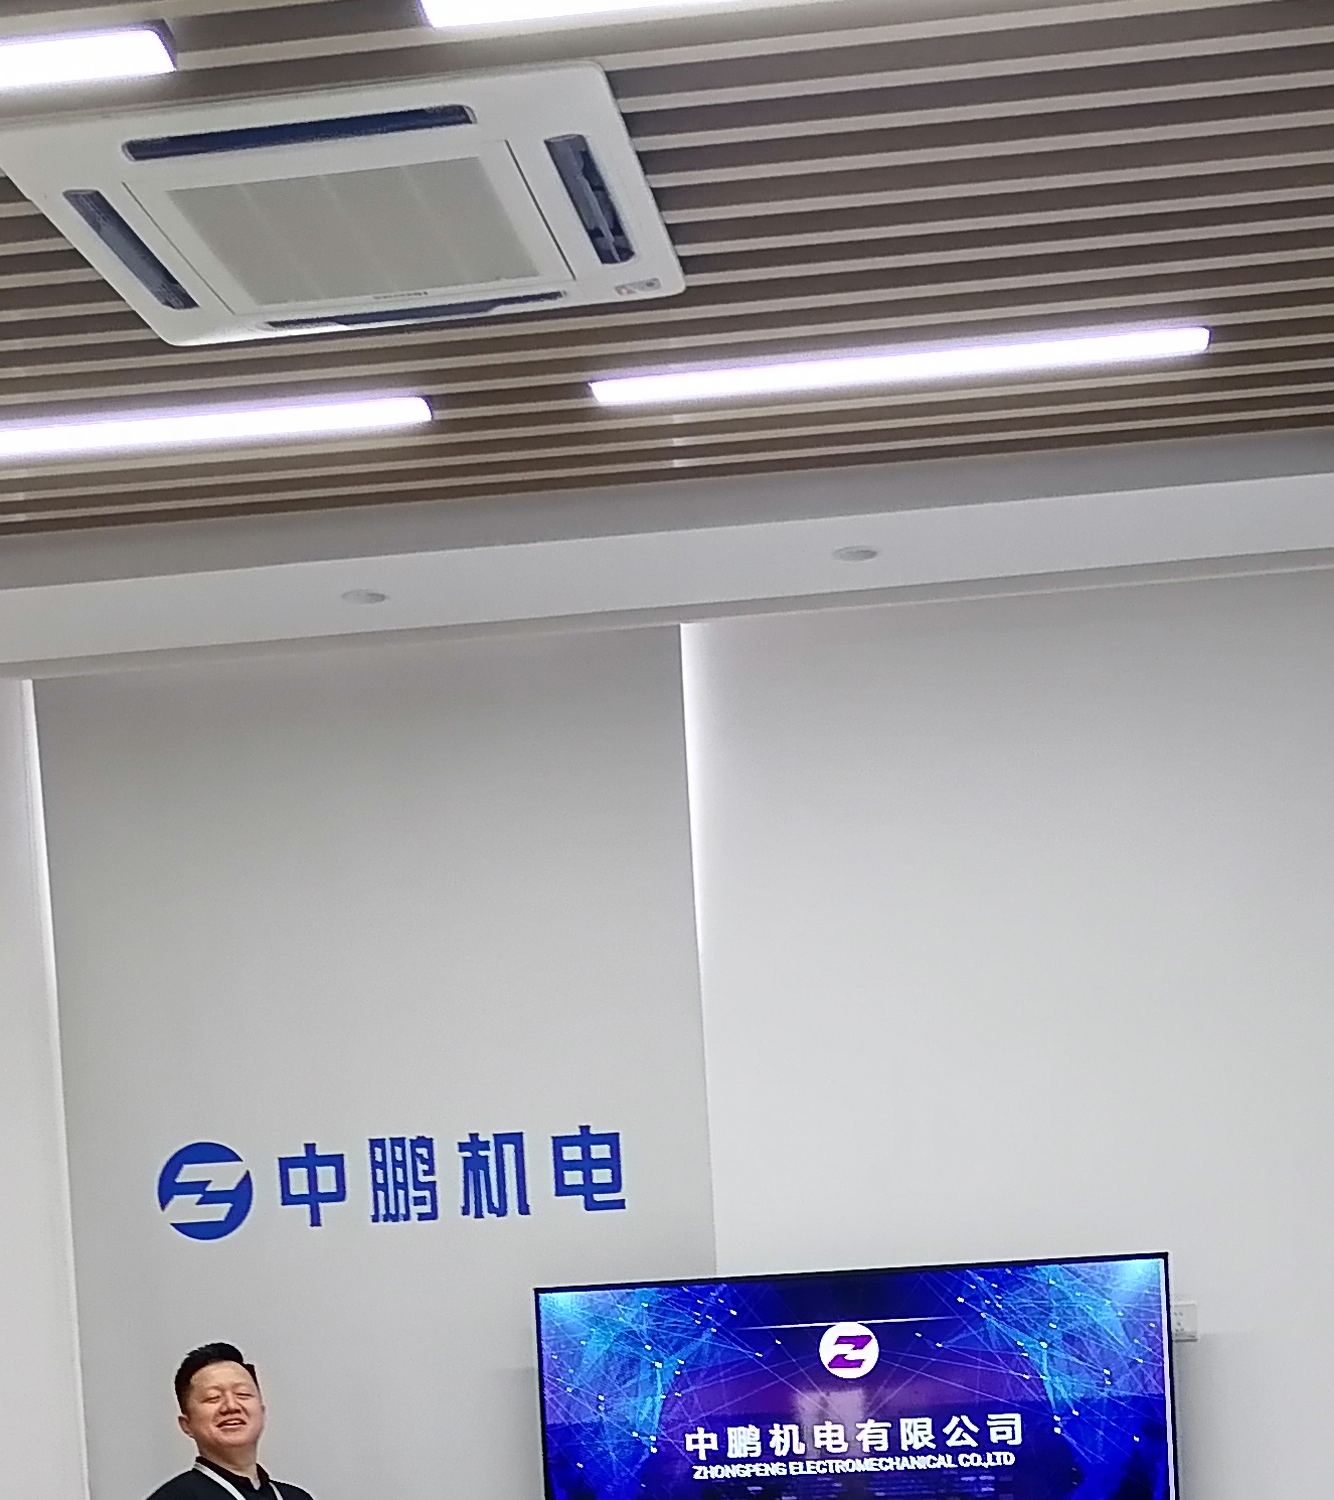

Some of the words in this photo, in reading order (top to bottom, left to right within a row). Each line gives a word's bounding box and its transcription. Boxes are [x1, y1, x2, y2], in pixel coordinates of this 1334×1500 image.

[277, 1123, 628, 1228] 中鹏机电
[685, 1413, 1023, 1460] 中鹏机电有限公司
[692, 1462, 788, 1480] ZHONGPENG
[789, 1454, 957, 1476] ELECTROMECHANICAL
